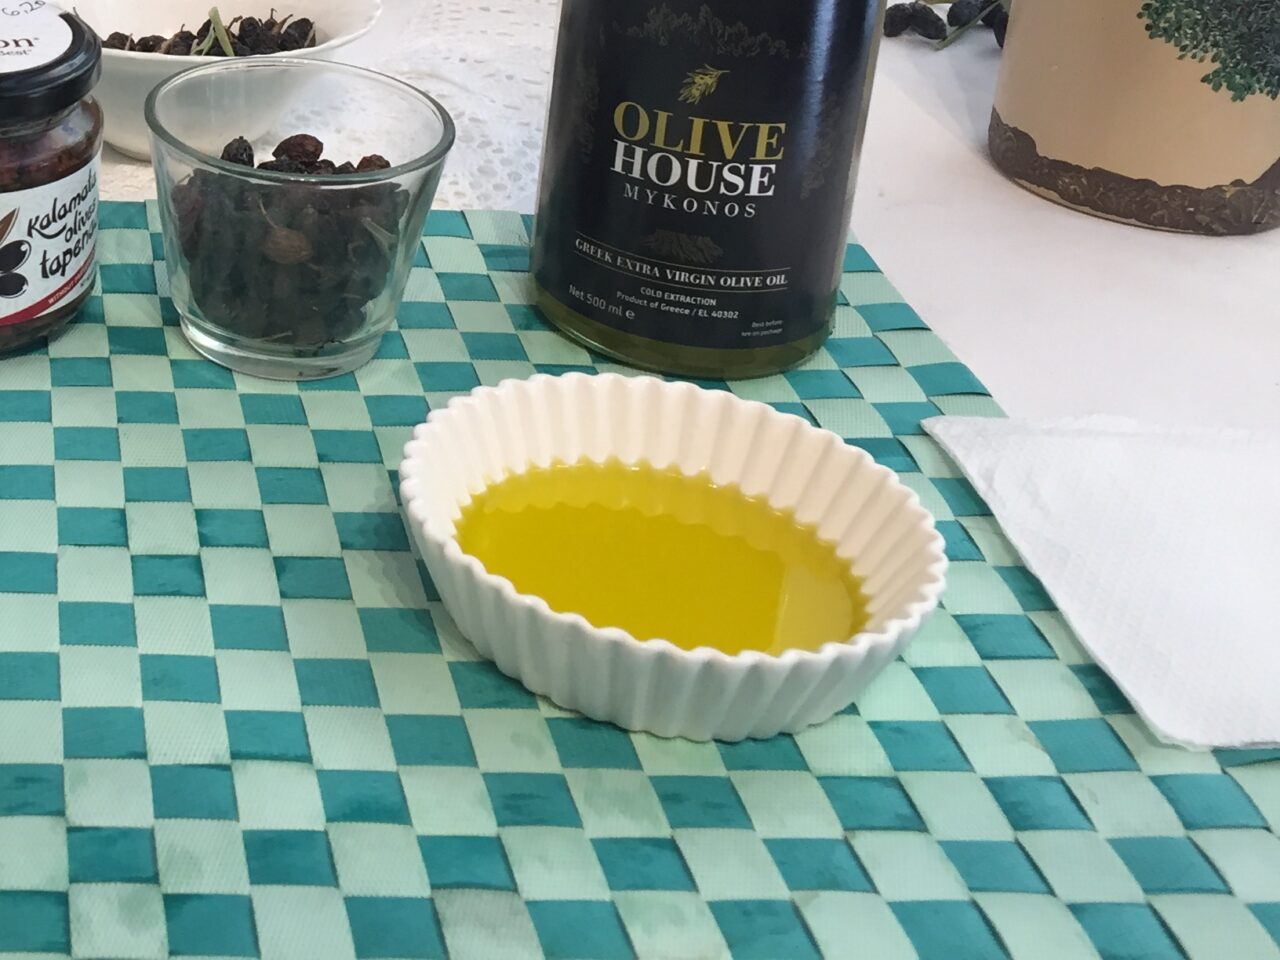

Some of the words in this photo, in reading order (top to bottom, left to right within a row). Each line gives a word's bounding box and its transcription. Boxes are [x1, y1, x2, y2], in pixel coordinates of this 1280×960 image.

[613, 100, 787, 161] OLIVE
[610, 138, 776, 197] HOUSE
[623, 183, 757, 218] MYKONOS
[575, 238, 612, 263] GREEK
[617, 256, 660, 278] EXTRA
[665, 268, 716, 286] VIRGIN
[720, 276, 763, 287] OLIVE
[766, 274, 788, 285] OIL
[569, 284, 585, 301] Net
[587, 293, 606, 310] 500
[608, 301, 622, 316] ml
[616, 291, 648, 306] Product
[650, 300, 658, 308] of
[661, 303, 690, 316] Greece
[698, 309, 709, 318] EL
[711, 310, 739, 319] 40302
[640, 286, 662, 298] COLD
[664, 291, 716, 306] EXTRACTION
